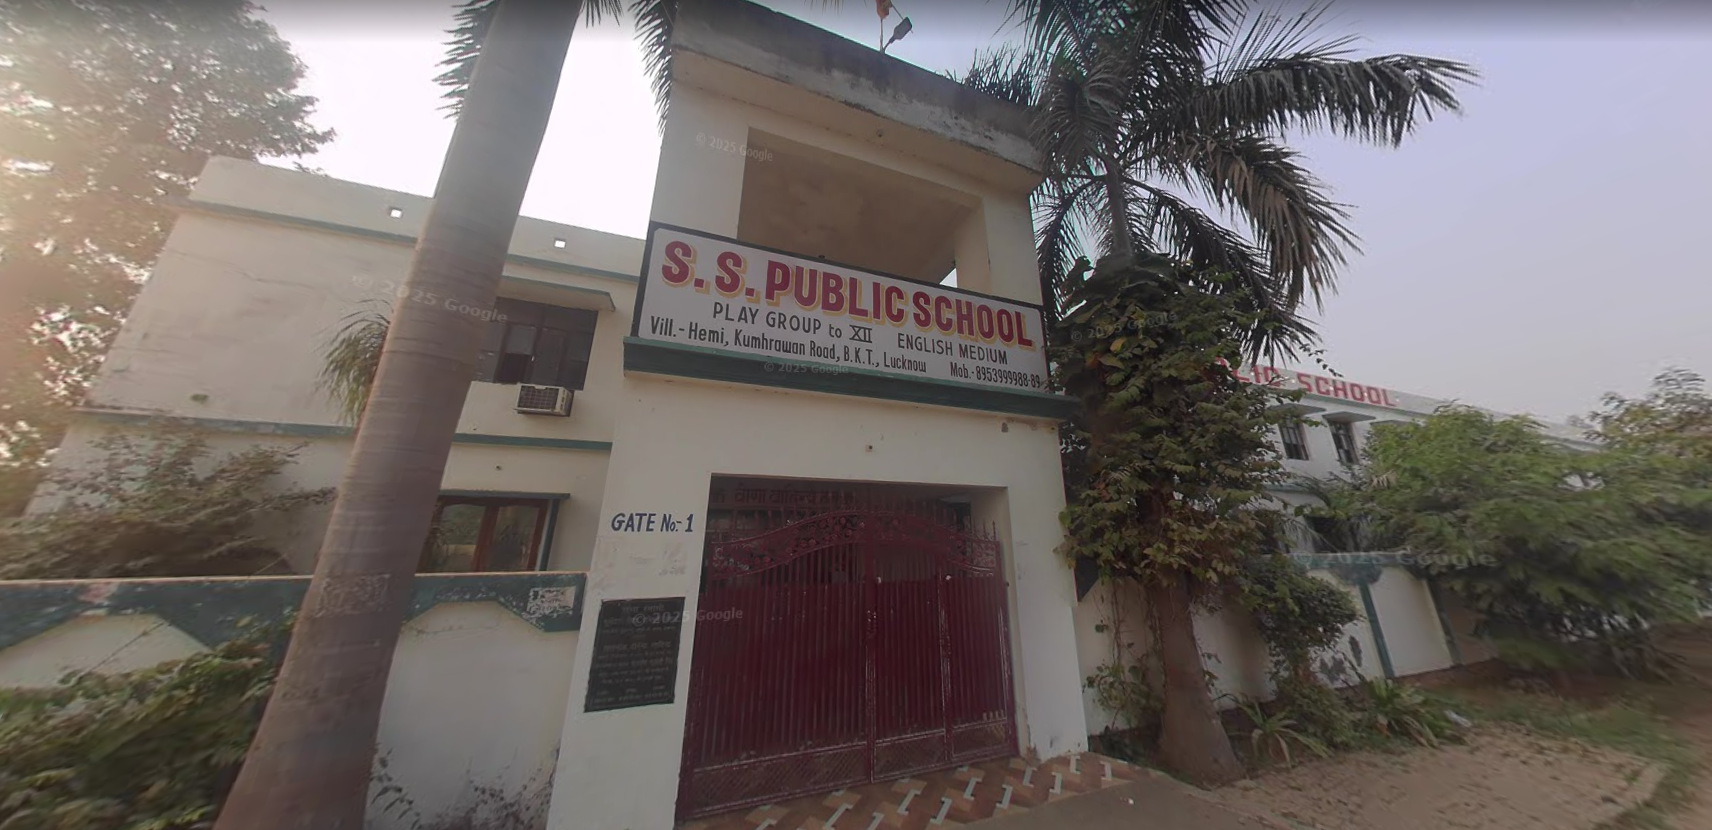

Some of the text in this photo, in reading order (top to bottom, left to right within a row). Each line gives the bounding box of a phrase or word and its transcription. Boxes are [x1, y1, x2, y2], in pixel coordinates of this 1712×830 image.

[764, 259, 905, 325] PUBLIC
[912, 291, 1034, 348] SCHOOL
[713, 302, 873, 344] PLAY GROUP to XII
[688, 321, 729, 347] Hemi,
[734, 329, 805, 356] Kumhrawan
[810, 341, 840, 363] Road,
[884, 352, 927, 373] Lucknow
[897, 333, 1008, 365] ENGLISH MEDIUM
[1296, 372, 1397, 406] SCHOOL
[611, 513, 657, 532] GATE
